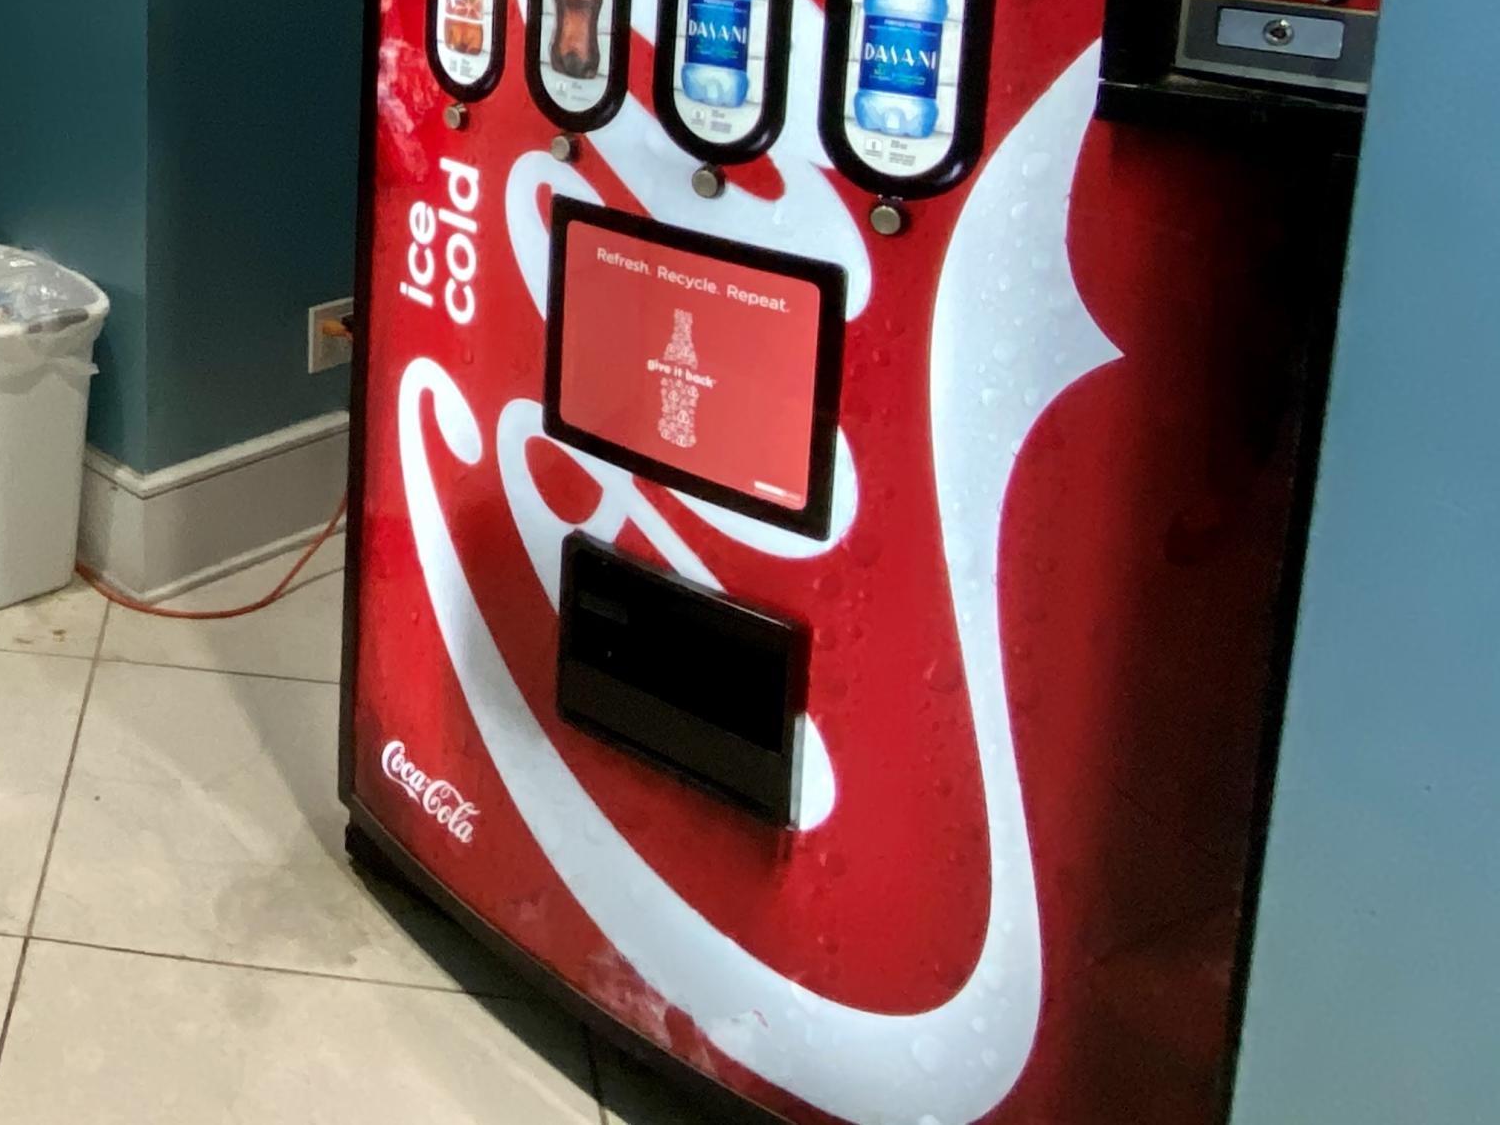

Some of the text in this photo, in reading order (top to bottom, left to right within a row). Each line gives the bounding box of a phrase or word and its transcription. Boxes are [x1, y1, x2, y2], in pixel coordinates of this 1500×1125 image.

[688, 18, 748, 45] DASANI
[864, 42, 937, 70] DASANI
[399, 201, 436, 307] ice
[438, 157, 480, 324] cold
[647, 358, 672, 375] give
[674, 365, 683, 378] it
